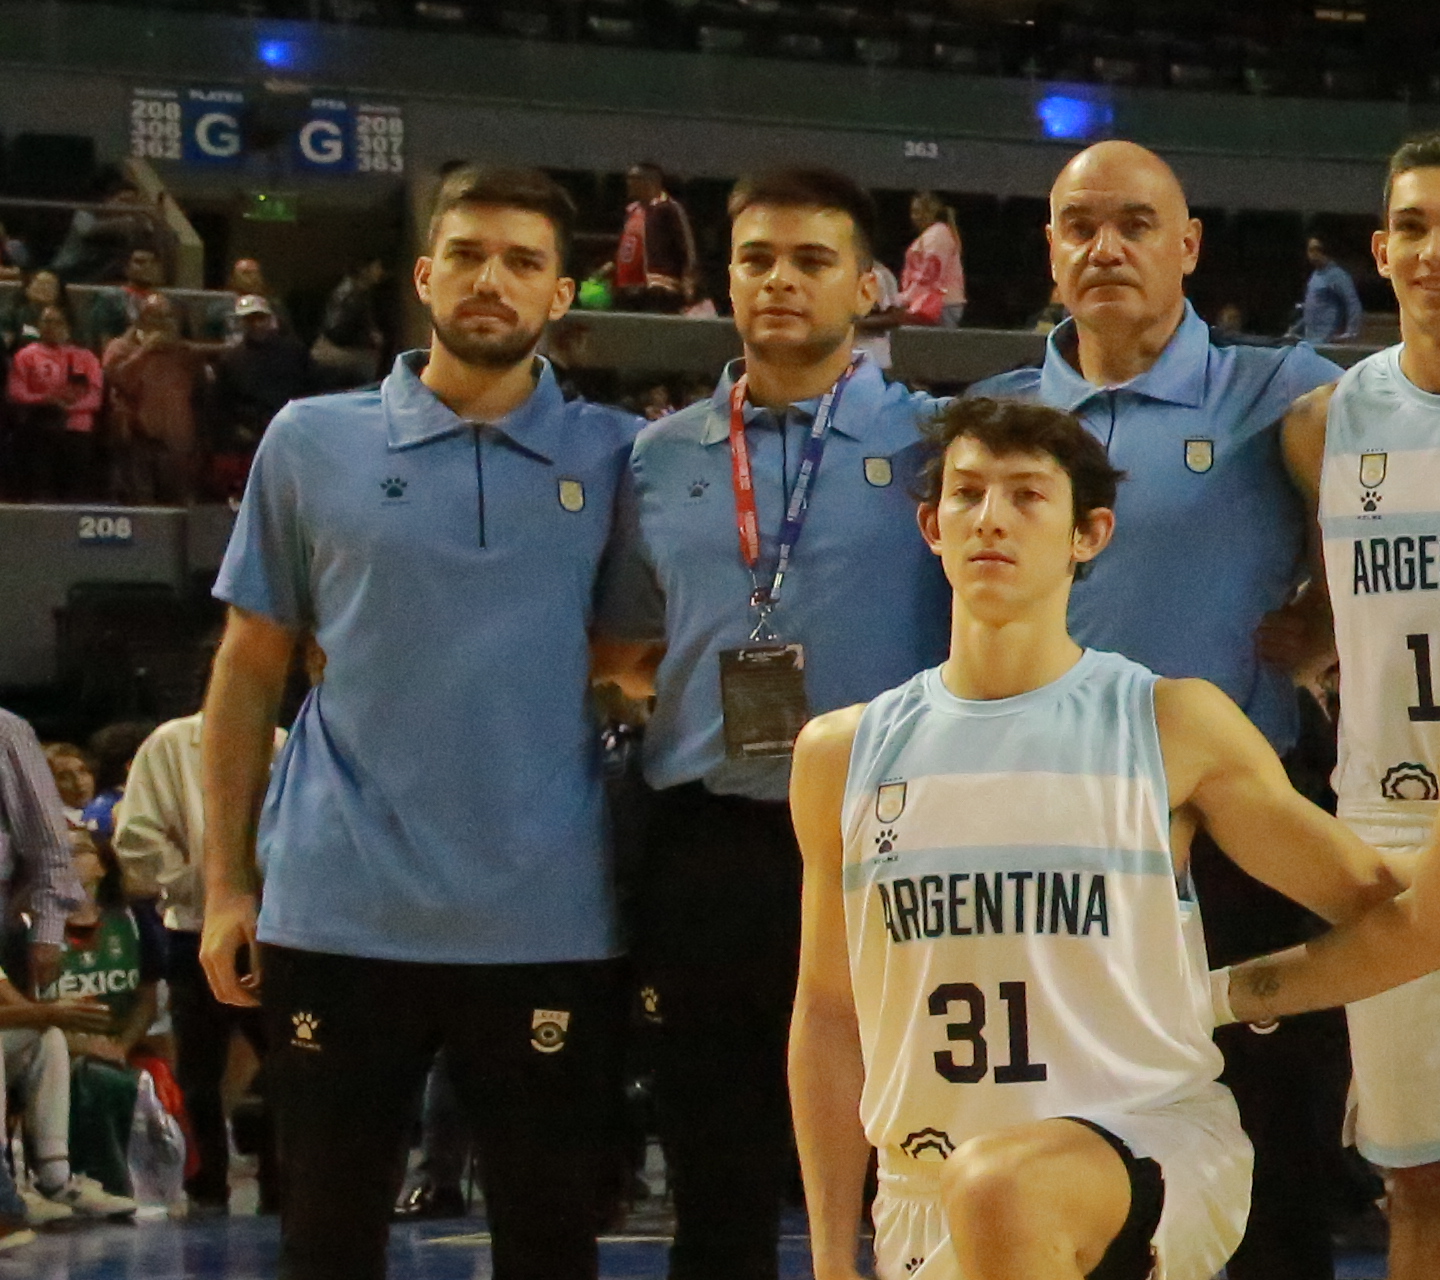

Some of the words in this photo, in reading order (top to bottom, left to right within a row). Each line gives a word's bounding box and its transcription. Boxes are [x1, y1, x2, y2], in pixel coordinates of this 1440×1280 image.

[195, 112, 242, 158] G
[299, 119, 343, 164] G
[878, 872, 1110, 946] ARGENTINA
[928, 981, 1047, 1086] 31
